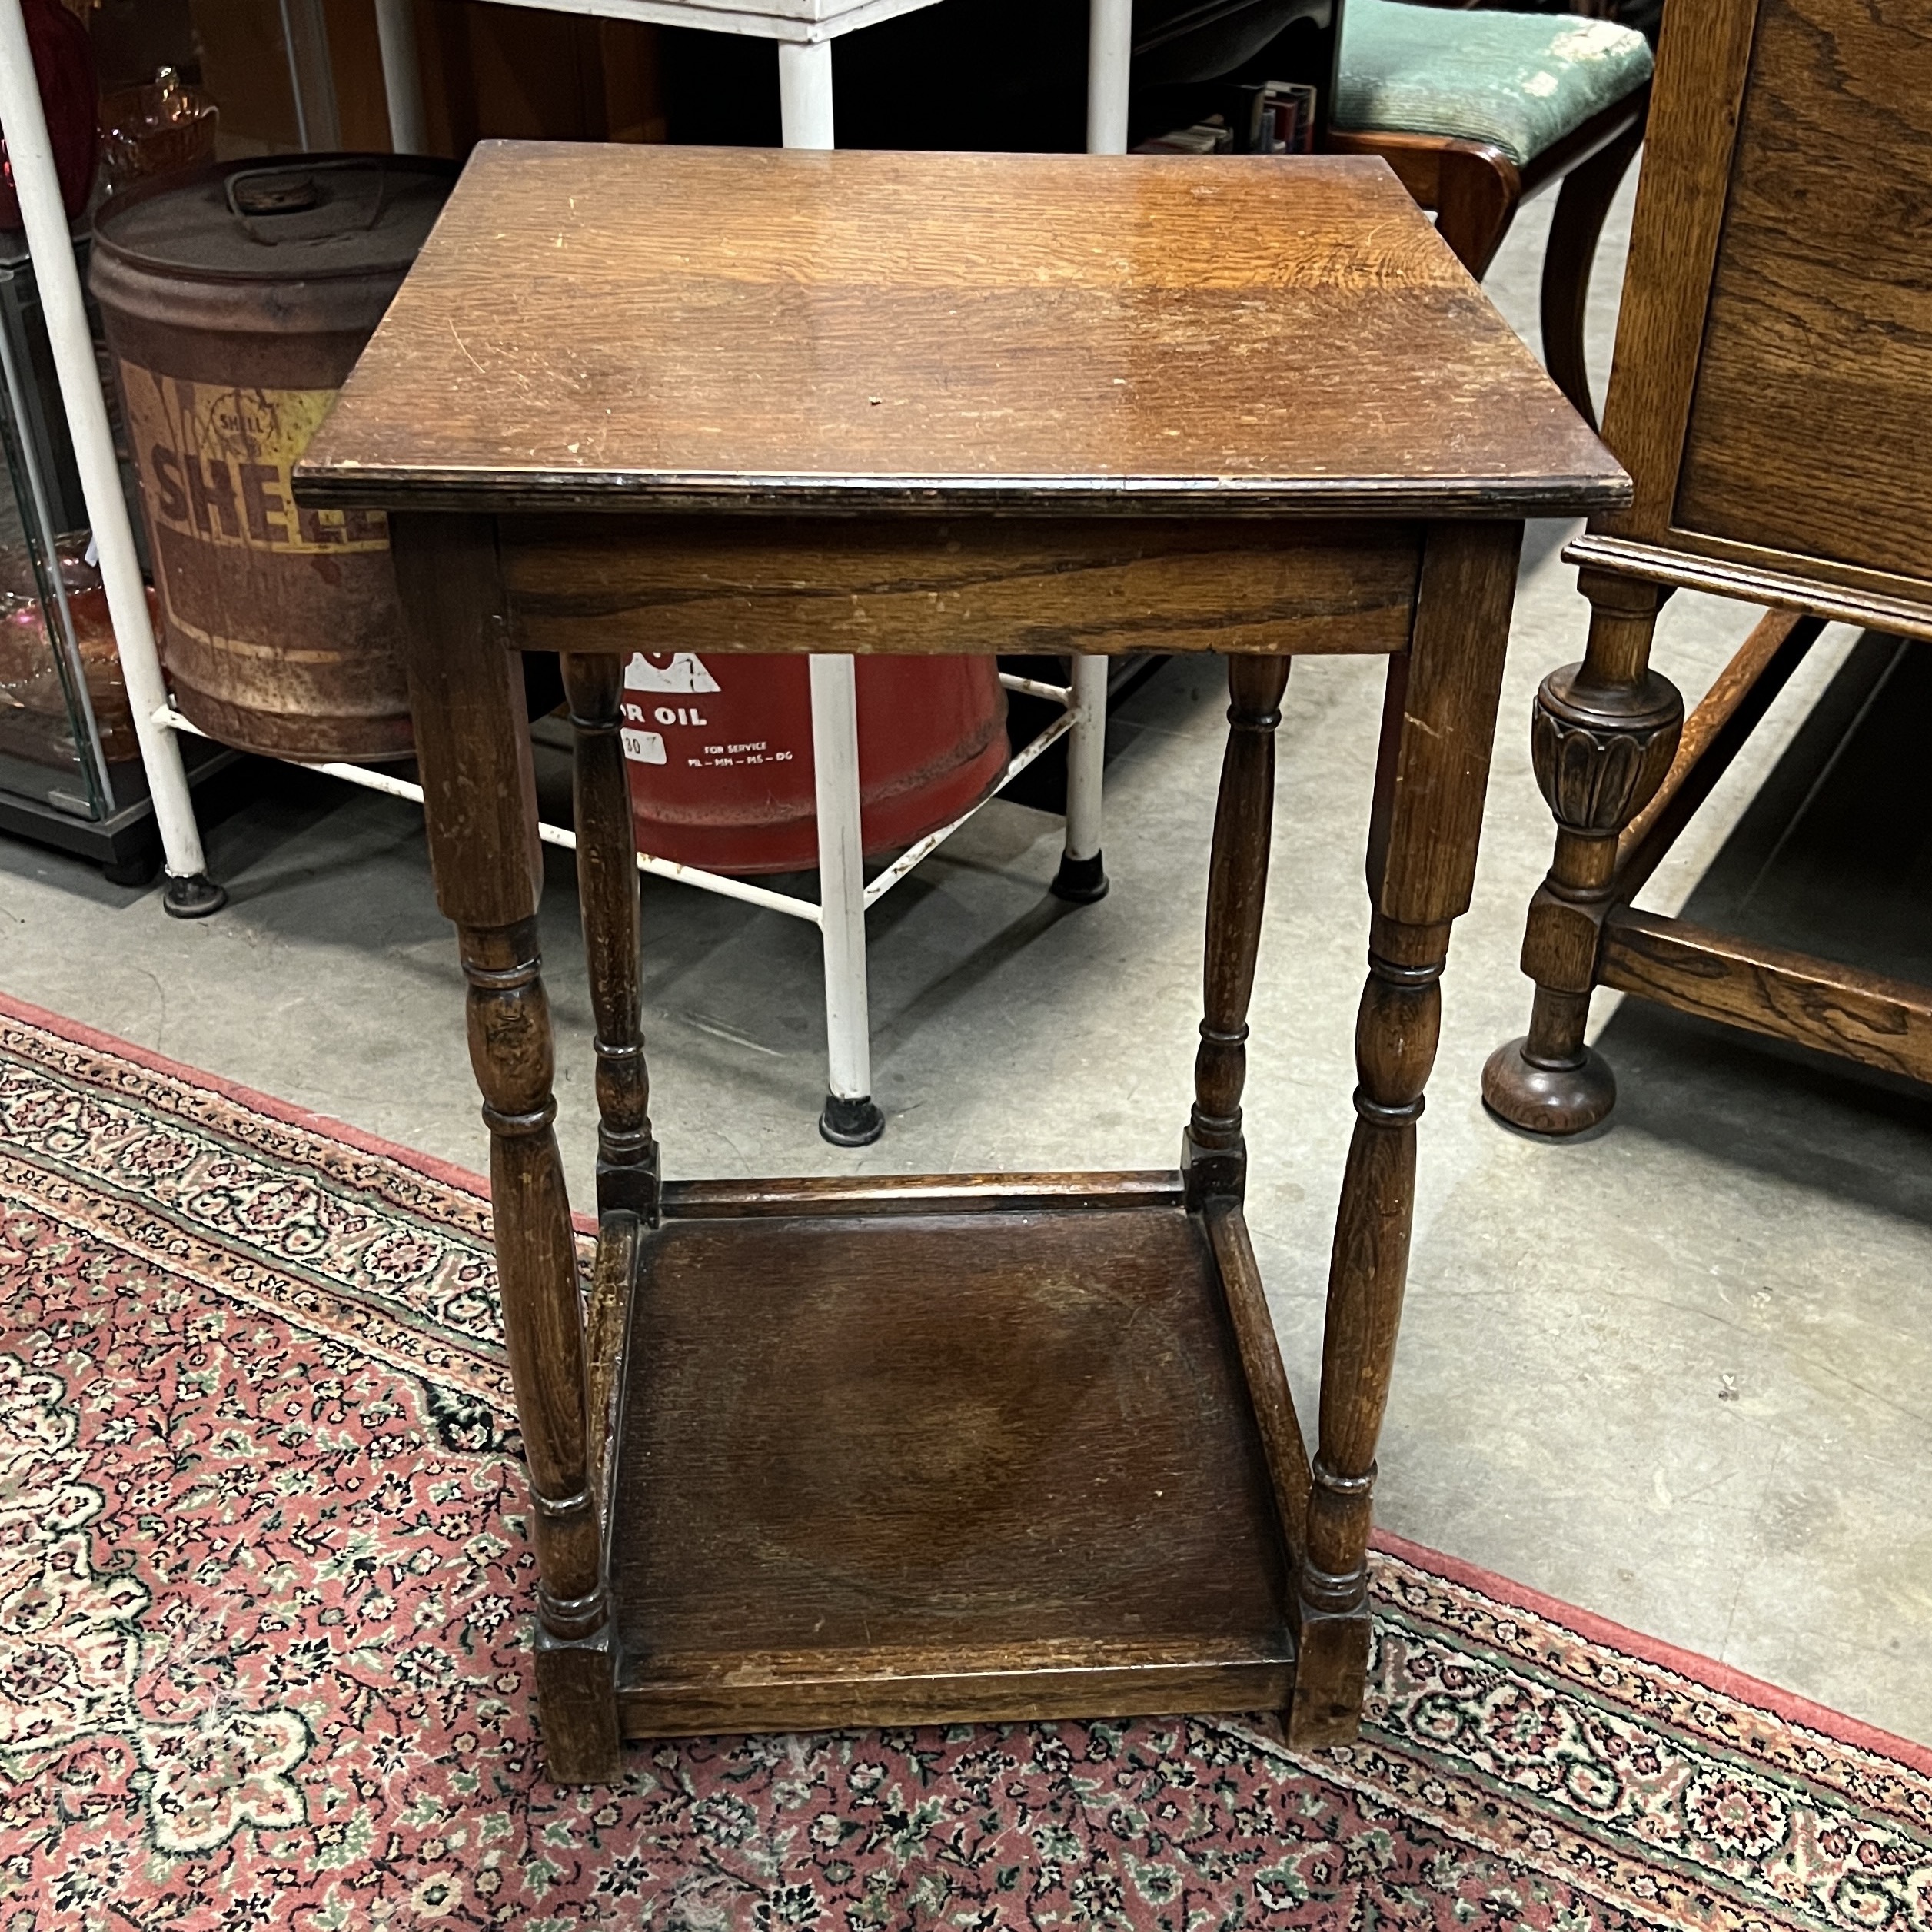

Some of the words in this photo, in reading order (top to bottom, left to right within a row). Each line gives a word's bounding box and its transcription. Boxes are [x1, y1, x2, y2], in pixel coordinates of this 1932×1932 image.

[654, 707, 707, 726] OIL
[704, 745, 724, 754] FOR
[727, 741, 767, 754] SERVICE
